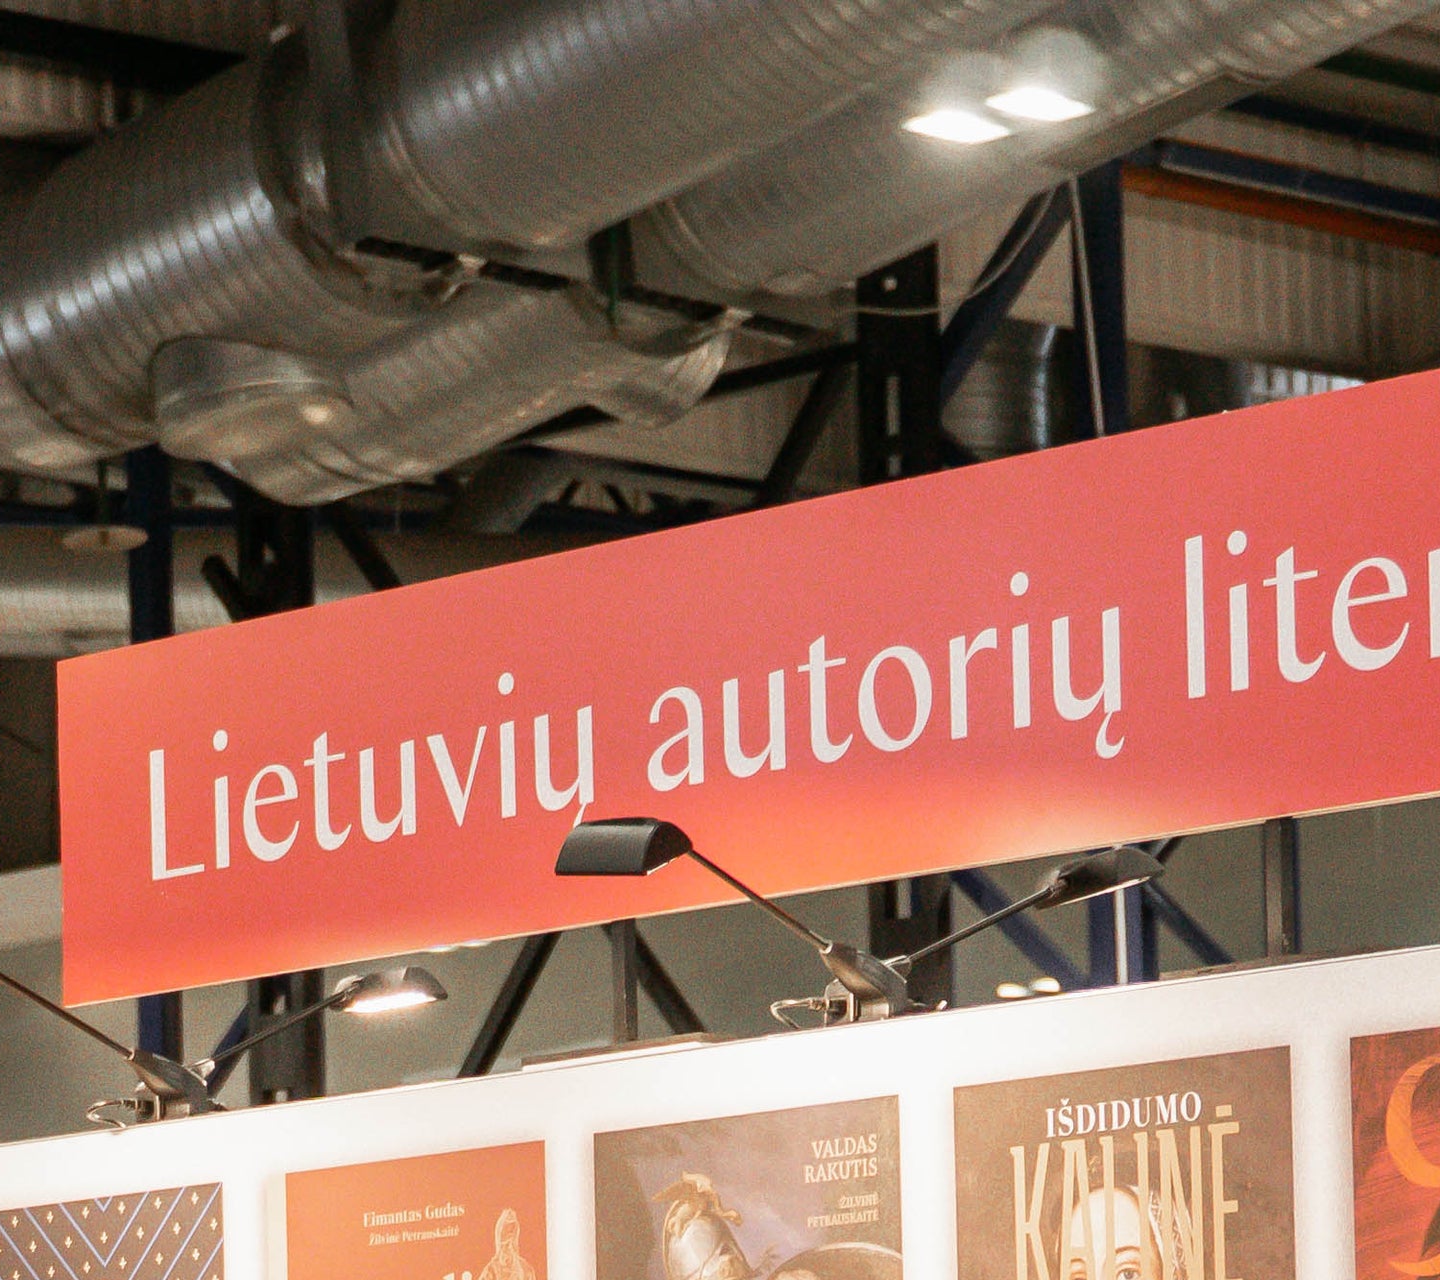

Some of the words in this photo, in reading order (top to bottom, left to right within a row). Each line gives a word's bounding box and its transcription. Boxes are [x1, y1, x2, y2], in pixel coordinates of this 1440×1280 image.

[144, 670, 596, 882] Lietuvių
[645, 569, 1127, 792] autorių
[1045, 1090, 1203, 1139] IŠDIDUMO
[811, 1134, 878, 1159] VALDAS
[804, 1157, 878, 1184] RAKUTIS
[363, 1208, 422, 1228] Eimantas
[424, 1201, 466, 1219] Gudas
